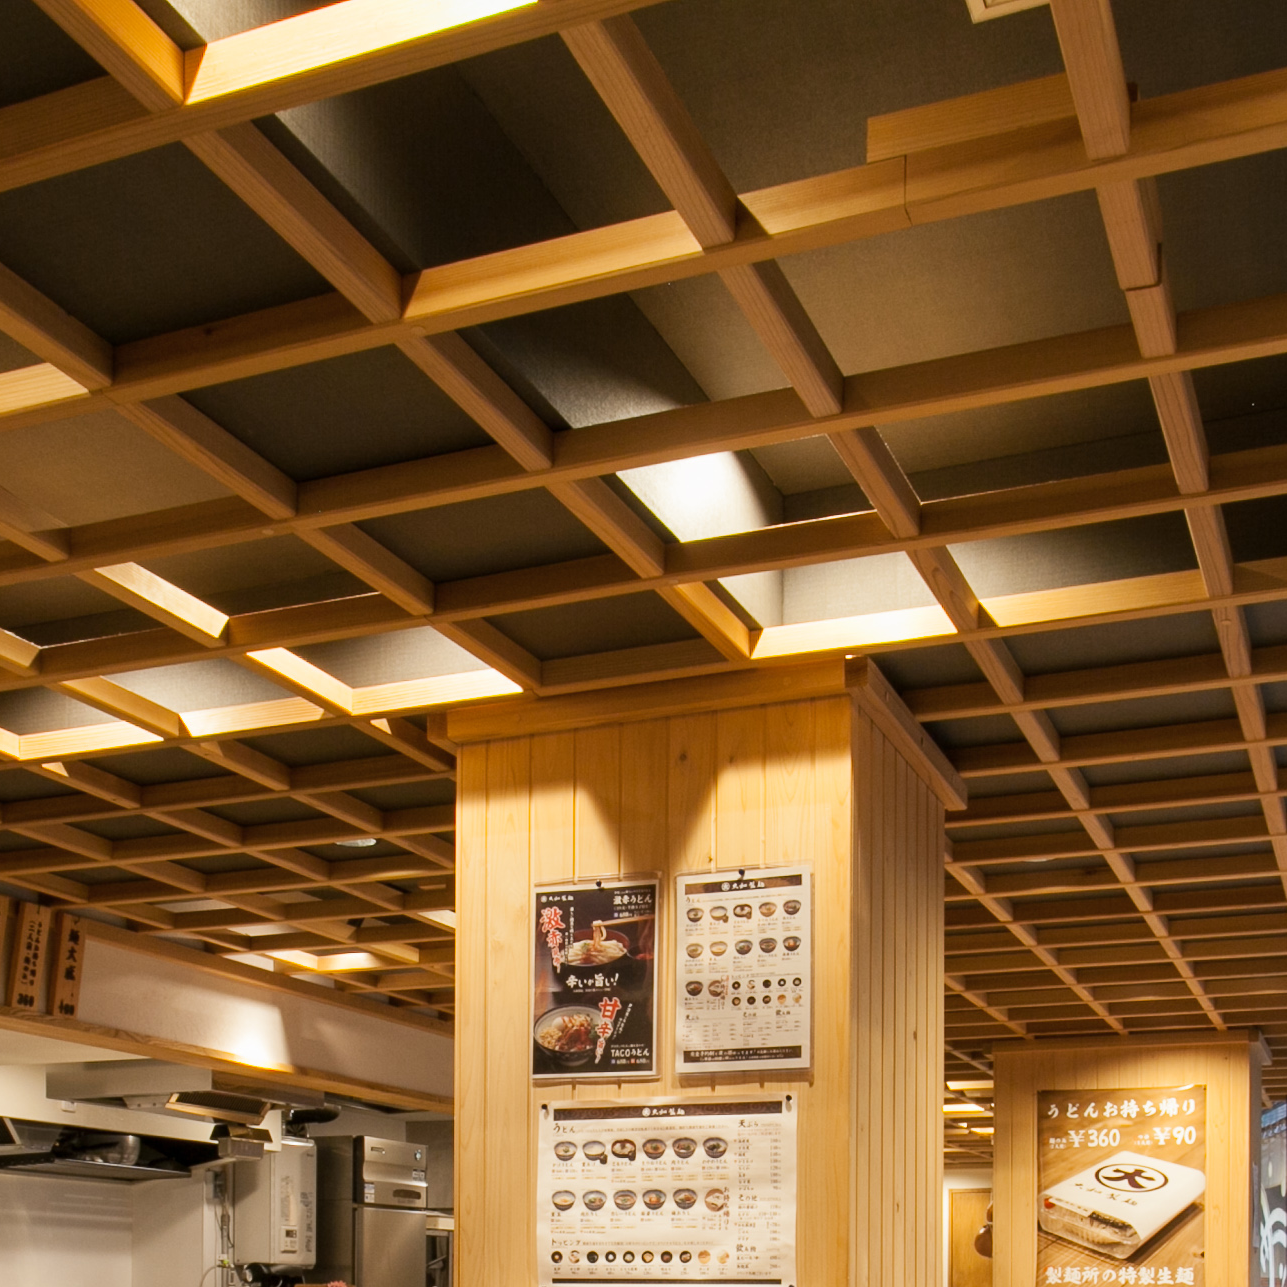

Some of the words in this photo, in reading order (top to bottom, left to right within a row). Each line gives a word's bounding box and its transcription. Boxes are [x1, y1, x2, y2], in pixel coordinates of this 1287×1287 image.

[1047, 1098, 1196, 1118] うどんお持ち帰り
[1045, 1266, 1195, 1287] 製麺所の特製生麺
